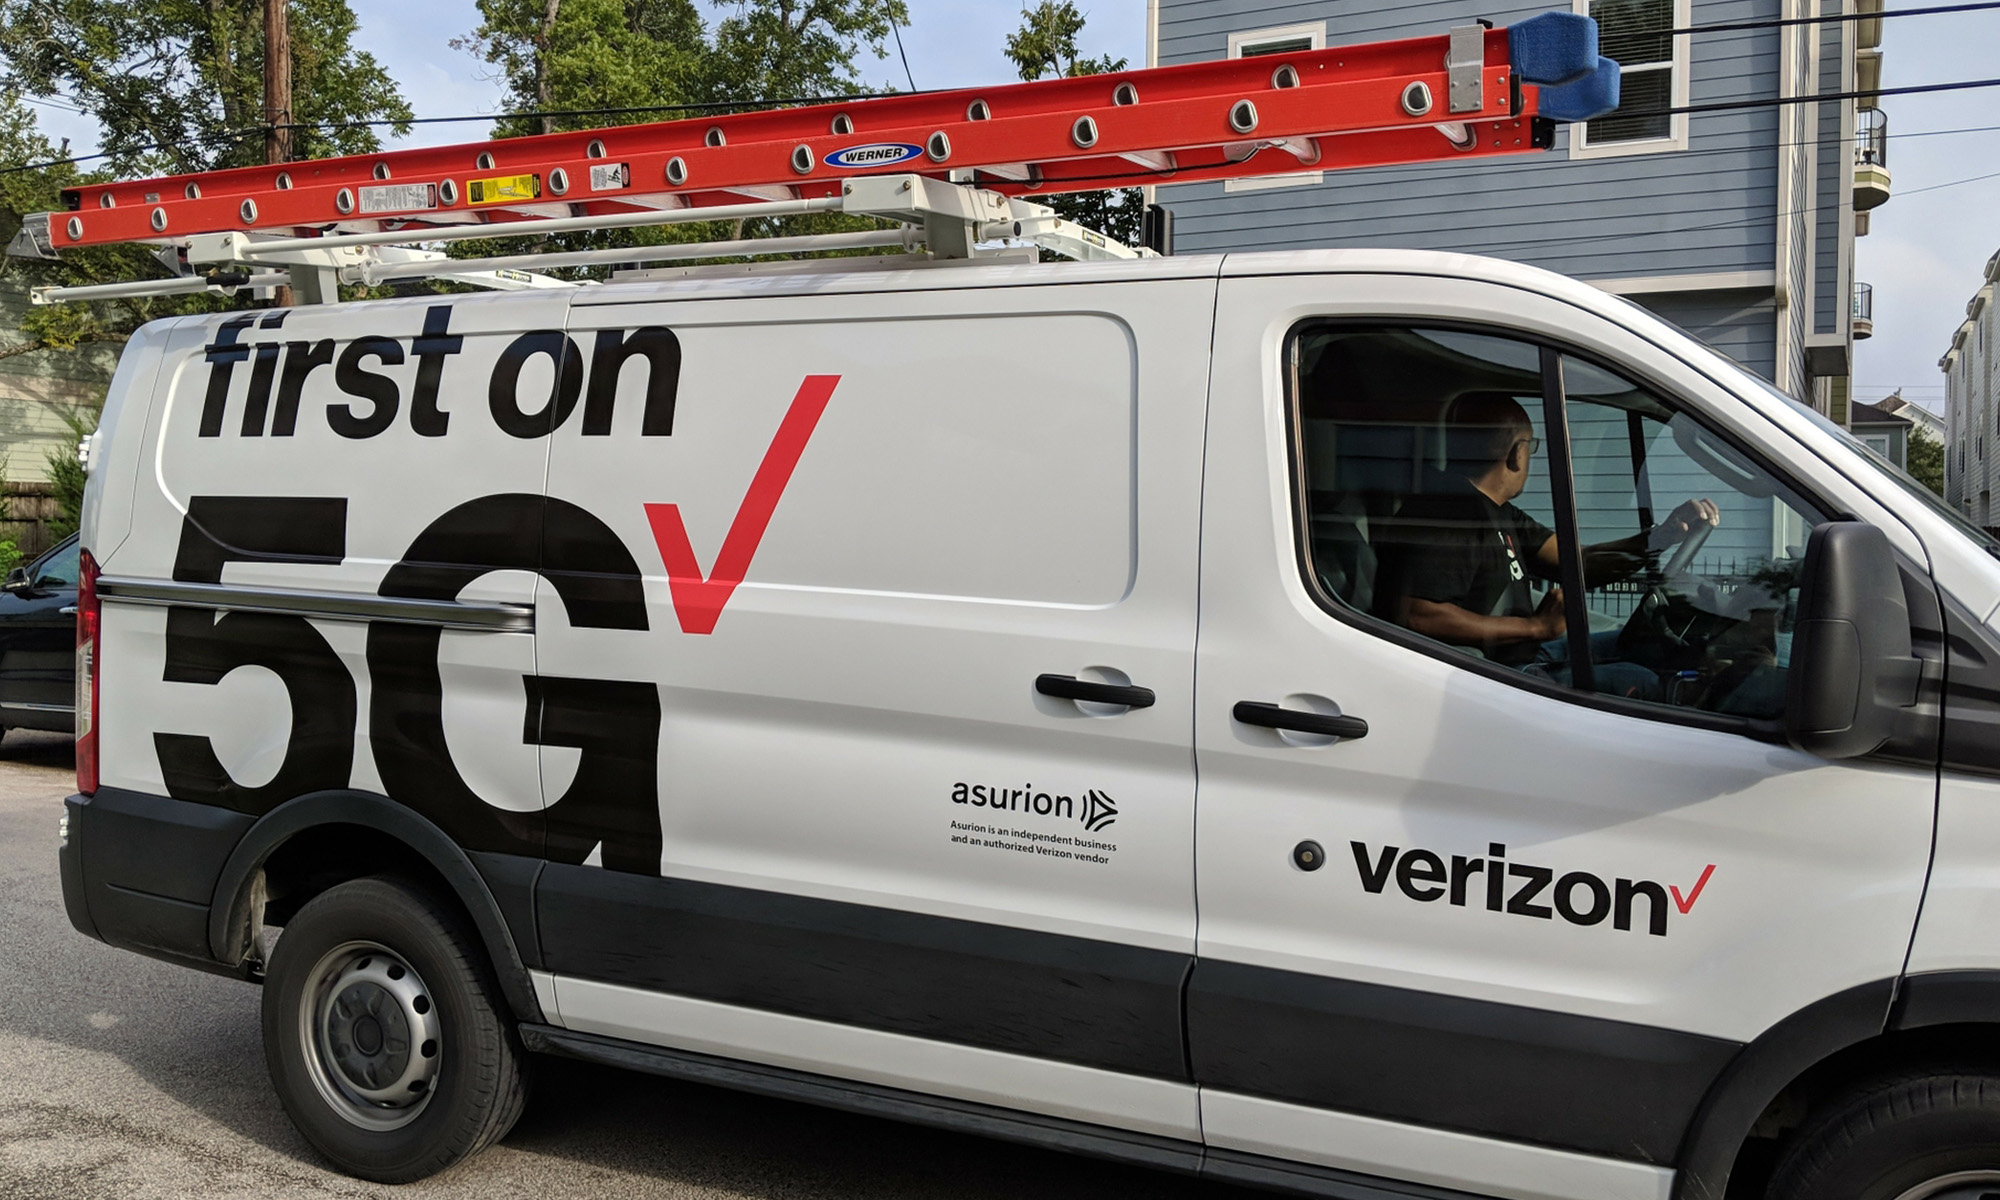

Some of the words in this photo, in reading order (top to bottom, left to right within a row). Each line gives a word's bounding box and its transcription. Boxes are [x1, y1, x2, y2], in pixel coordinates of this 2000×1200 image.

[845, 147, 903, 163] WERNER
[198, 305, 465, 440] first
[487, 325, 682, 440] on
[152, 492, 663, 877] 5G
[951, 782, 1073, 819] asurion
[950, 820, 986, 833] Asurion
[988, 825, 996, 834] is
[997, 828, 1009, 836] an
[1011, 828, 1073, 846] independent
[1074, 837, 1117, 852] business
[951, 834, 968, 844] and
[969, 838, 981, 846] an
[983, 840, 1034, 854] authorized
[1035, 845, 1072, 859] Verizon
[1074, 853, 1109, 864] vendor
[1349, 840, 1669, 937] verizon
